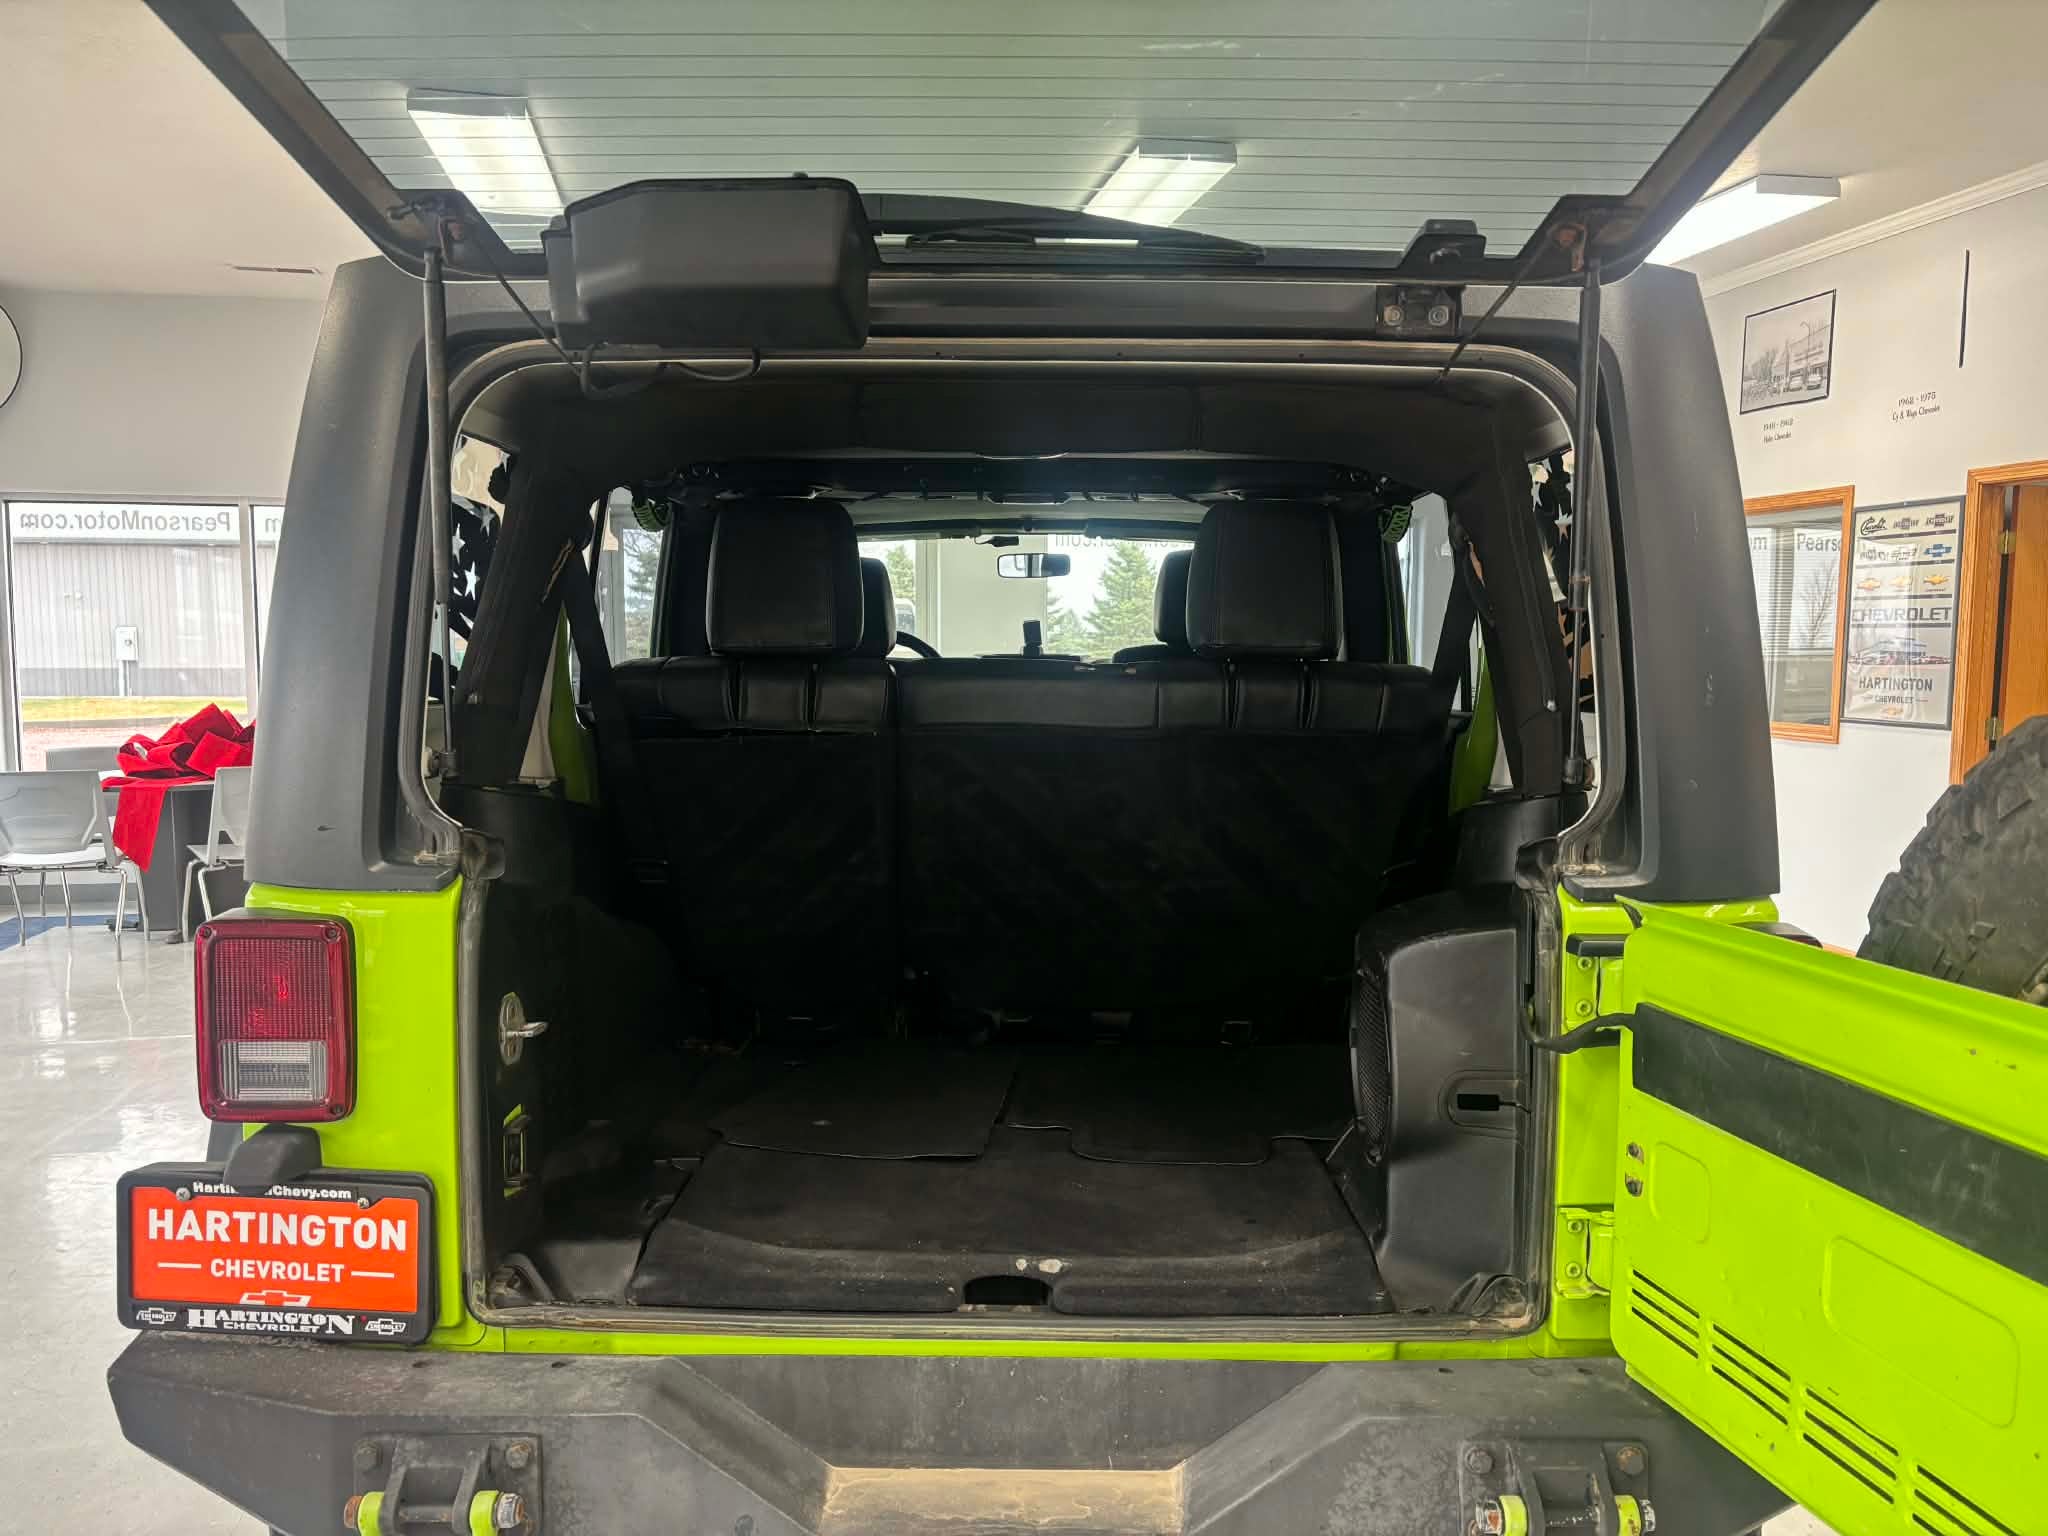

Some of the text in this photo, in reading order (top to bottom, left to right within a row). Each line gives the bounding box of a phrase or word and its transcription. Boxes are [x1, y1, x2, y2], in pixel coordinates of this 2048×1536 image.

[1851, 607, 1952, 623] CHEVROLET
[1858, 677, 1934, 692] HARTINGTON
[1874, 695, 1914, 705] CHEVROLET
[148, 1208, 407, 1251] HARTINGTON
[210, 1258, 345, 1283] CHEVROLET
[186, 1308, 355, 1335] HARTINGTON
[223, 1322, 320, 1334] CHEVROLET
